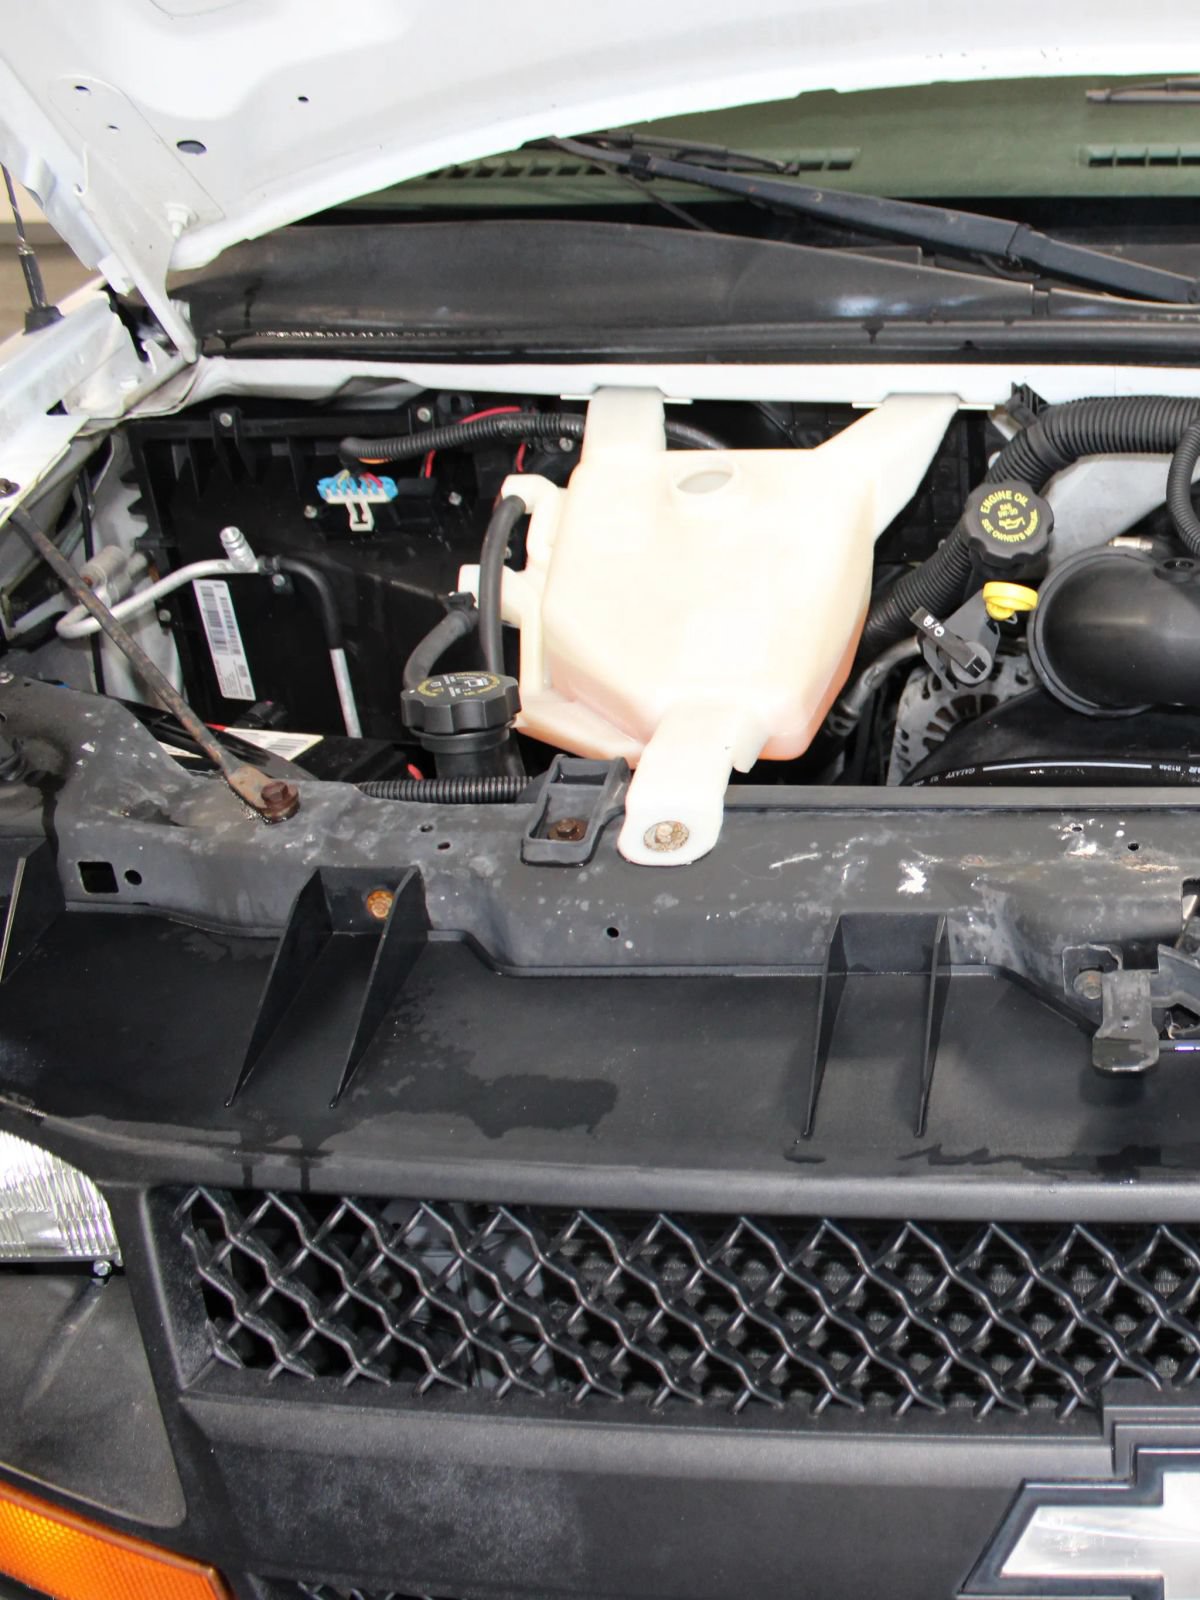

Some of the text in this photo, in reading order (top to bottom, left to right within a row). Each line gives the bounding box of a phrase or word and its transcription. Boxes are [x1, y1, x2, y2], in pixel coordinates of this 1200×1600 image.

[980, 490, 1028, 513] ENGINE OIL
[982, 518, 994, 533] SEE
[945, 767, 976, 779] GALAXY
